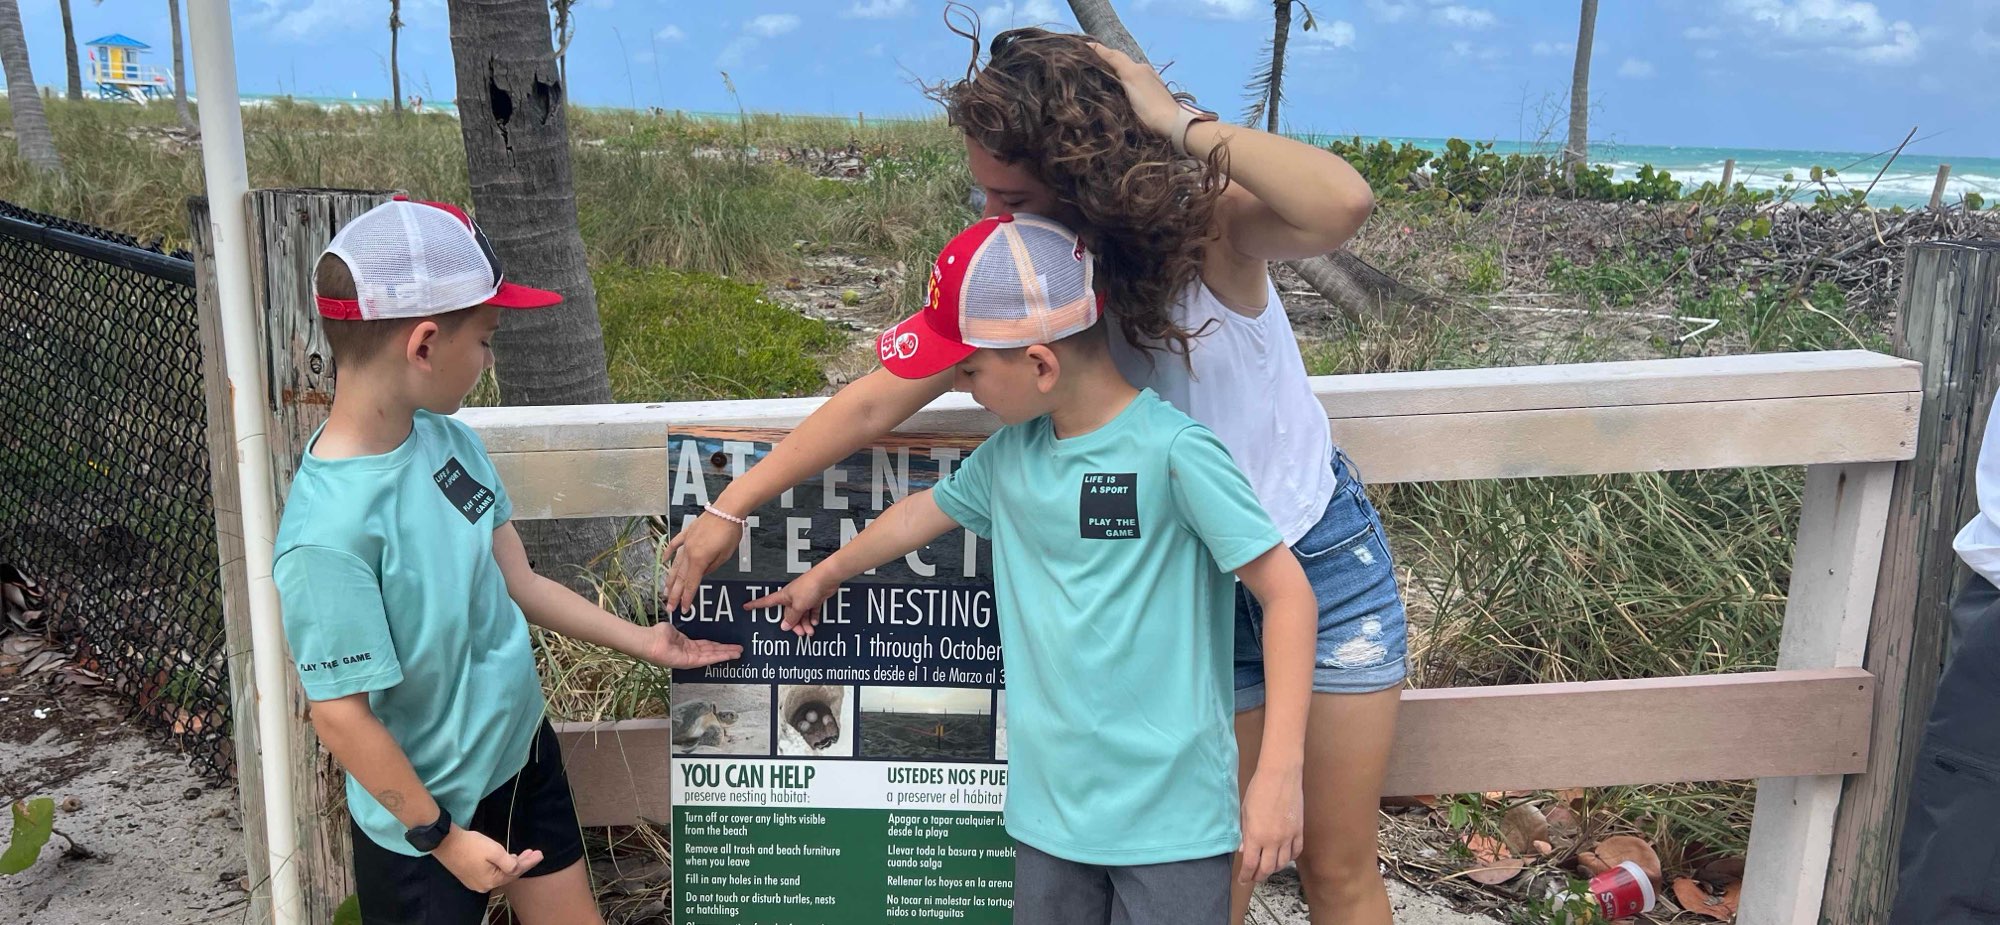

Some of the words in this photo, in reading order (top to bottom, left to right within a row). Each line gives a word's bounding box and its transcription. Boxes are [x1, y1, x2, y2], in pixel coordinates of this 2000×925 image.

[672, 440, 960, 510] ATENT
[463, 500, 474, 512] PLAY
[473, 488, 487, 501] THE
[476, 496, 493, 513] GAME
[746, 586, 850, 624] TULE
[868, 588, 991, 628] NESTING
[752, 632, 790, 656] from
[796, 633, 846, 656] March
[854, 634, 860, 656] 1
[870, 633, 932, 663] through
[940, 636, 1002, 661] October
[343, 653, 371, 664] GAME
[705, 663, 758, 679] Anidación
[762, 664, 775, 679] de
[779, 666, 823, 683] tortugas
[826, 666, 870, 681] marinas
[874, 665, 905, 681] desde
[908, 666, 918, 681] el
[922, 667, 928, 681] 1
[932, 666, 946, 682] de
[949, 668, 982, 683] Marzo
[986, 668, 996, 684] al
[681, 764, 720, 787] YOU
[725, 764, 764, 788] CAN
[770, 765, 816, 789] HELP
[888, 767, 943, 784] USTEDES
[948, 768, 976, 785] NOS
[980, 769, 1008, 786] PUE
[684, 790, 726, 804] preserve
[730, 790, 767, 805] nesting
[771, 789, 810, 803] habitat:
[886, 792, 893, 802] a
[898, 792, 946, 805] preserver
[950, 789, 959, 803] el
[964, 789, 1002, 804] hábitat
[684, 812, 703, 823] Turn
[706, 812, 718, 823] off
[719, 815, 728, 823] or
[731, 815, 753, 824] cover
[756, 815, 771, 826] any
[773, 813, 797, 826] lights
[799, 814, 826, 825] visible
[888, 813, 920, 826] Apagar
[931, 814, 953, 826] tapar
[955, 814, 995, 828] cualquier
[684, 825, 705, 835] from
[707, 825, 721, 836] the
[723, 825, 748, 836] beach
[888, 826, 912, 836] desde
[915, 826, 923, 837] la
[926, 826, 948, 839] playa
[685, 844, 718, 854] Remove
[720, 844, 731, 854] all
[734, 844, 755, 855] trash
[757, 844, 774, 855] and
[776, 844, 801, 856] beach
[803, 845, 840, 856] furniture
[888, 845, 914, 856] Llevar
[916, 845, 935, 856] toda
[938, 845, 946, 856] la
[948, 846, 976, 856] basura
[979, 849, 984, 859] y
[685, 856, 707, 866] when
[710, 858, 725, 868] you
[728, 856, 750, 866] leave
[887, 857, 917, 868] cuando
[920, 858, 942, 870] salga
[685, 873, 698, 884] Fill
[701, 874, 709, 884] in
[711, 876, 727, 887] any
[729, 874, 751, 885] holes
[753, 874, 762, 885] in
[764, 875, 778, 885] the
[780, 875, 800, 886] sand
[887, 876, 922, 886] Rellenar
[925, 876, 936, 887] los
[939, 876, 962, 889] hoyos
[978, 877, 985, 888] la
[686, 892, 697, 902] Do
[700, 893, 713, 902] not
[716, 892, 738, 903] touch
[740, 895, 750, 903] or
[752, 893, 781, 904] disturb
[783, 893, 812, 905] turtles,
[815, 895, 836, 904] nests
[886, 894, 898, 905] No
[901, 896, 922, 905] tocar
[924, 896, 932, 905] ni
[935, 895, 971, 906] molestar
[974, 896, 985, 906] las
[988, 897, 1014, 908] tortug
[697, 904, 739, 917] hatchlings
[886, 906, 908, 917] nidos
[919, 908, 964, 919] tortuguitas
